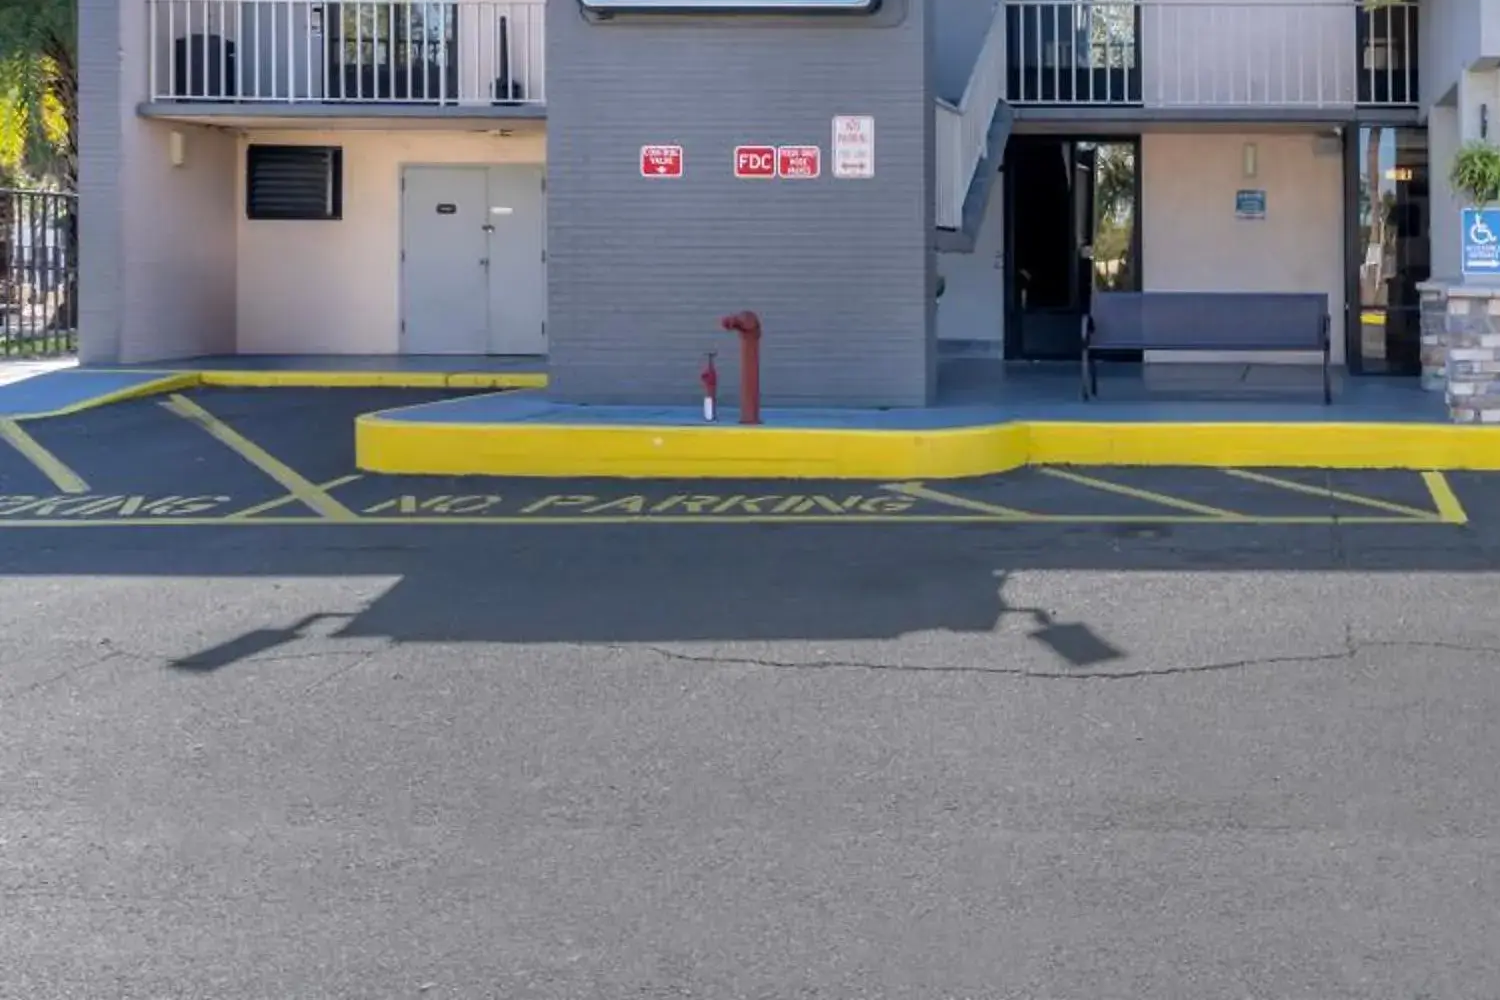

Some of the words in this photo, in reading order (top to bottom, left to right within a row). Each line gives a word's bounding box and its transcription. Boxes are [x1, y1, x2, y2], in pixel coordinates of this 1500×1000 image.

[739, 153, 771, 170] FDC
[361, 494, 503, 514] NO
[520, 494, 919, 514] PARKING
